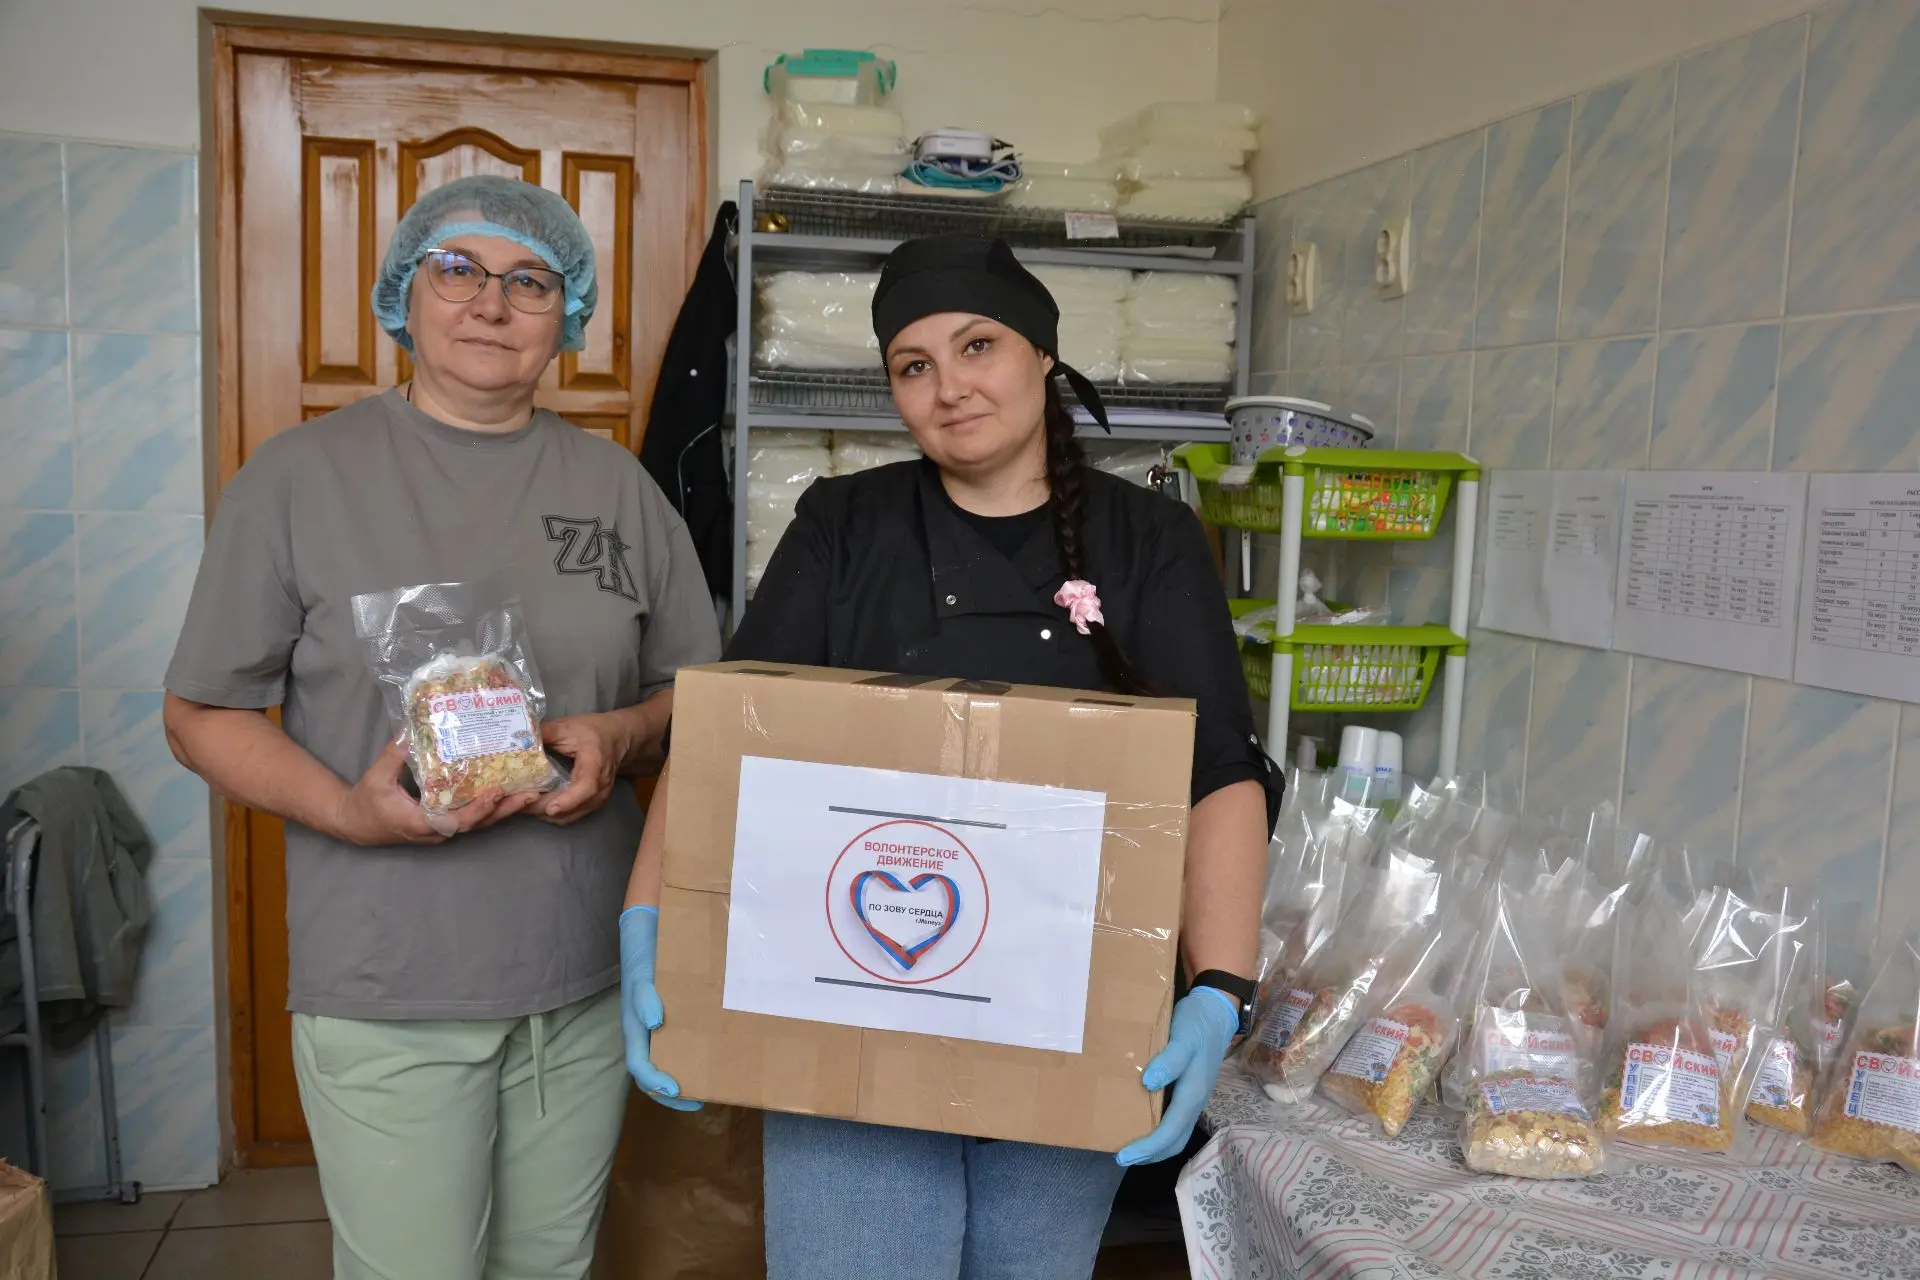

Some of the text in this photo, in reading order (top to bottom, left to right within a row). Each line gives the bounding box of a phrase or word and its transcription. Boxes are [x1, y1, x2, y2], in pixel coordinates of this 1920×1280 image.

[864, 841, 960, 860] ВОЛОНТЕРСКОЕ
[876, 855, 945, 871] ДВИЖЕНИЕ
[868, 903, 944, 918] ПО ЗОВУ СЕРДЦА
